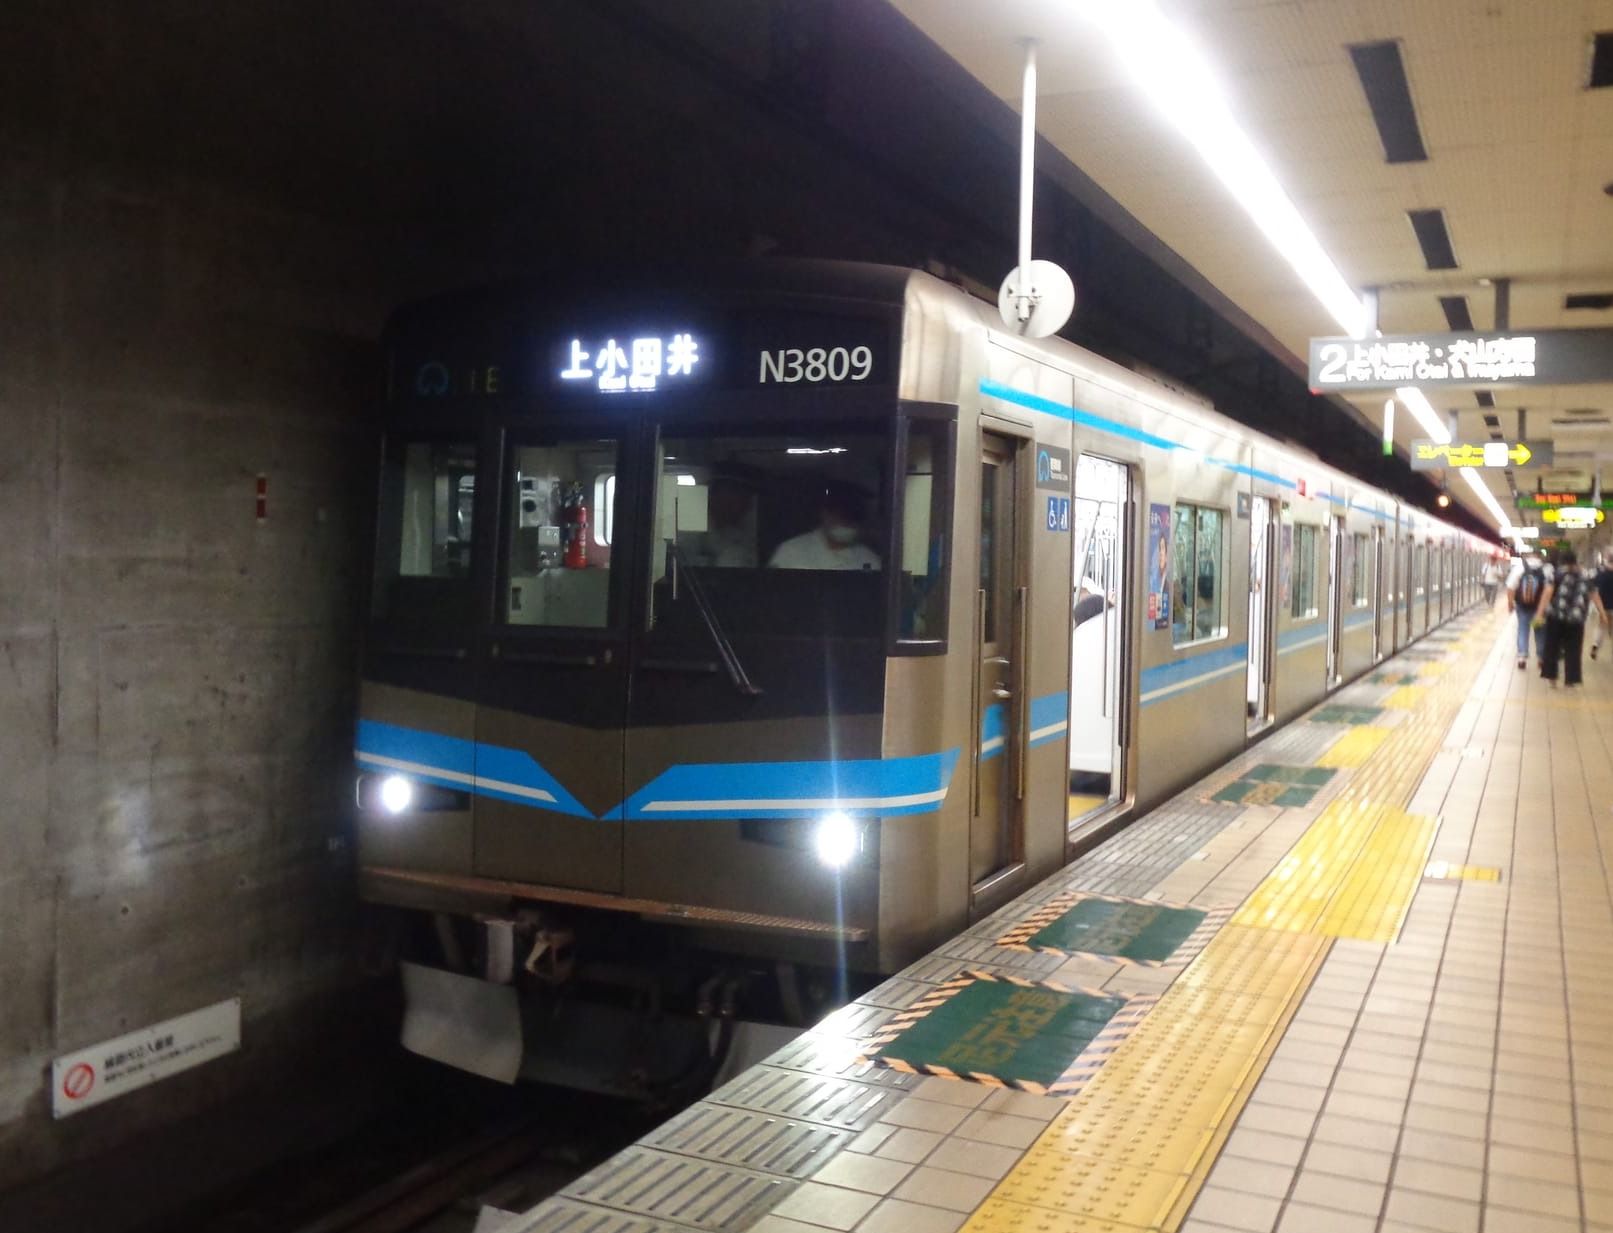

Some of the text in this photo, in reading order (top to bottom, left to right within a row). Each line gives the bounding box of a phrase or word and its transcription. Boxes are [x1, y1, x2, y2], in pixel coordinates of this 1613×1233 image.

[561, 334, 699, 379] 上小田井
[759, 345, 873, 383] N3809
[1319, 343, 1347, 383] 2
